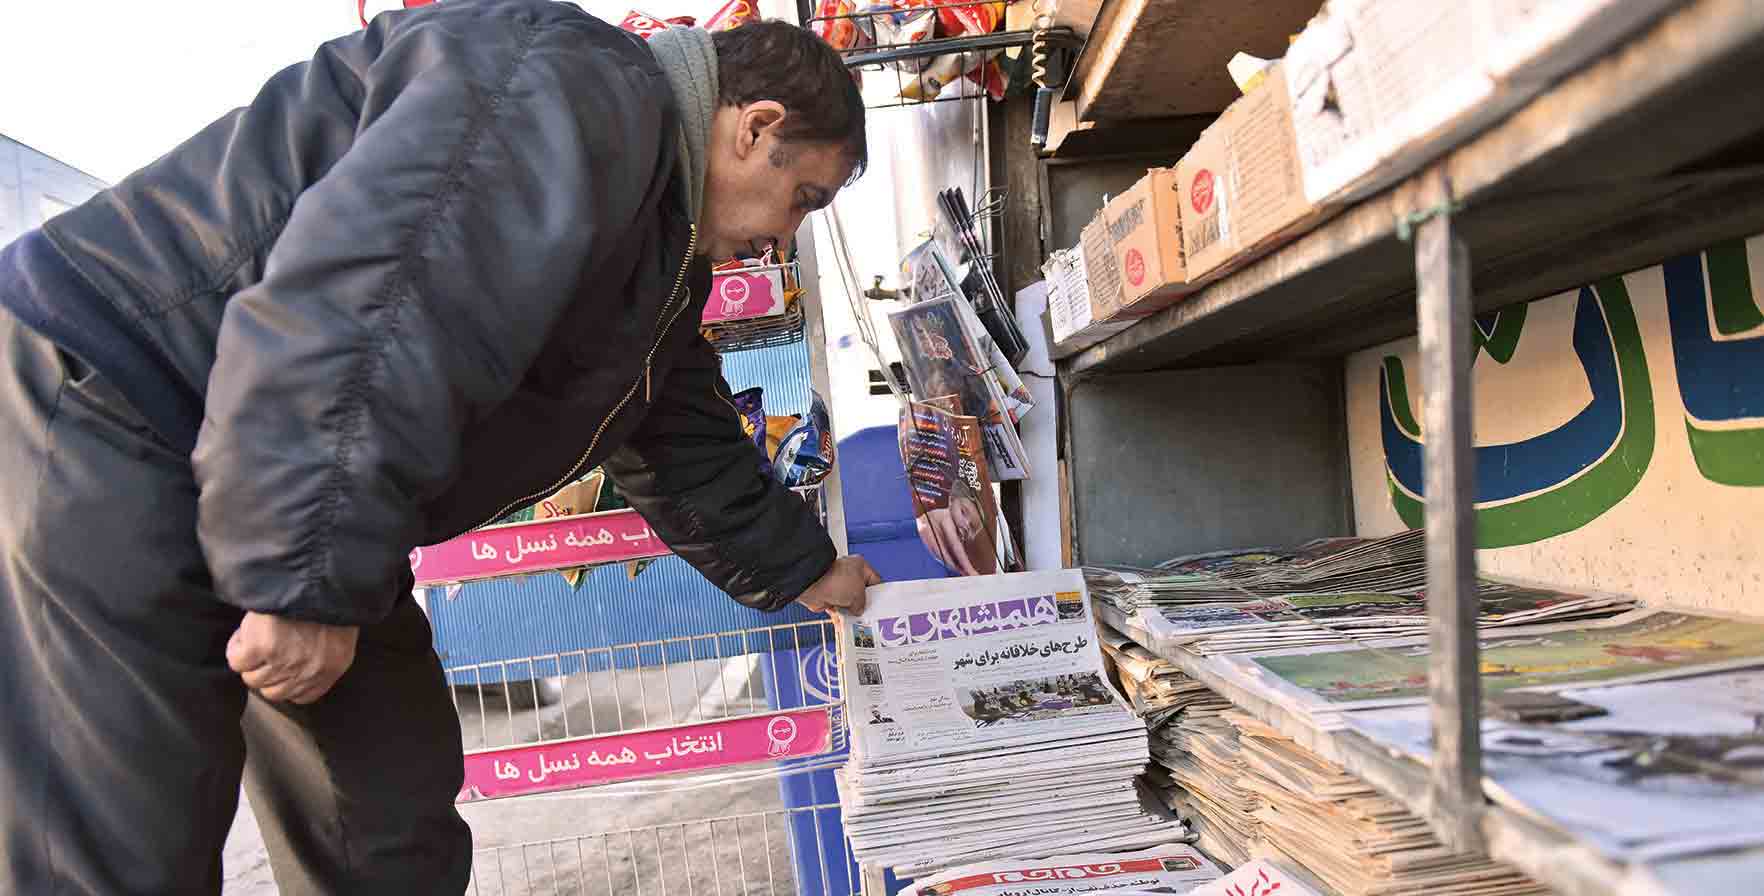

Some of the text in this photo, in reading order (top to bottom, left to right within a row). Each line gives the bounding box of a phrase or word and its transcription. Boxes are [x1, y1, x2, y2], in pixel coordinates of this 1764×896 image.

[565, 528, 615, 549] همه
[471, 540, 498, 562] ها
[504, 534, 558, 566] نسل
[953, 653, 975, 671] شهر
[975, 650, 1001, 666] برای
[493, 731, 725, 783] انتخاب همه نسل ها
